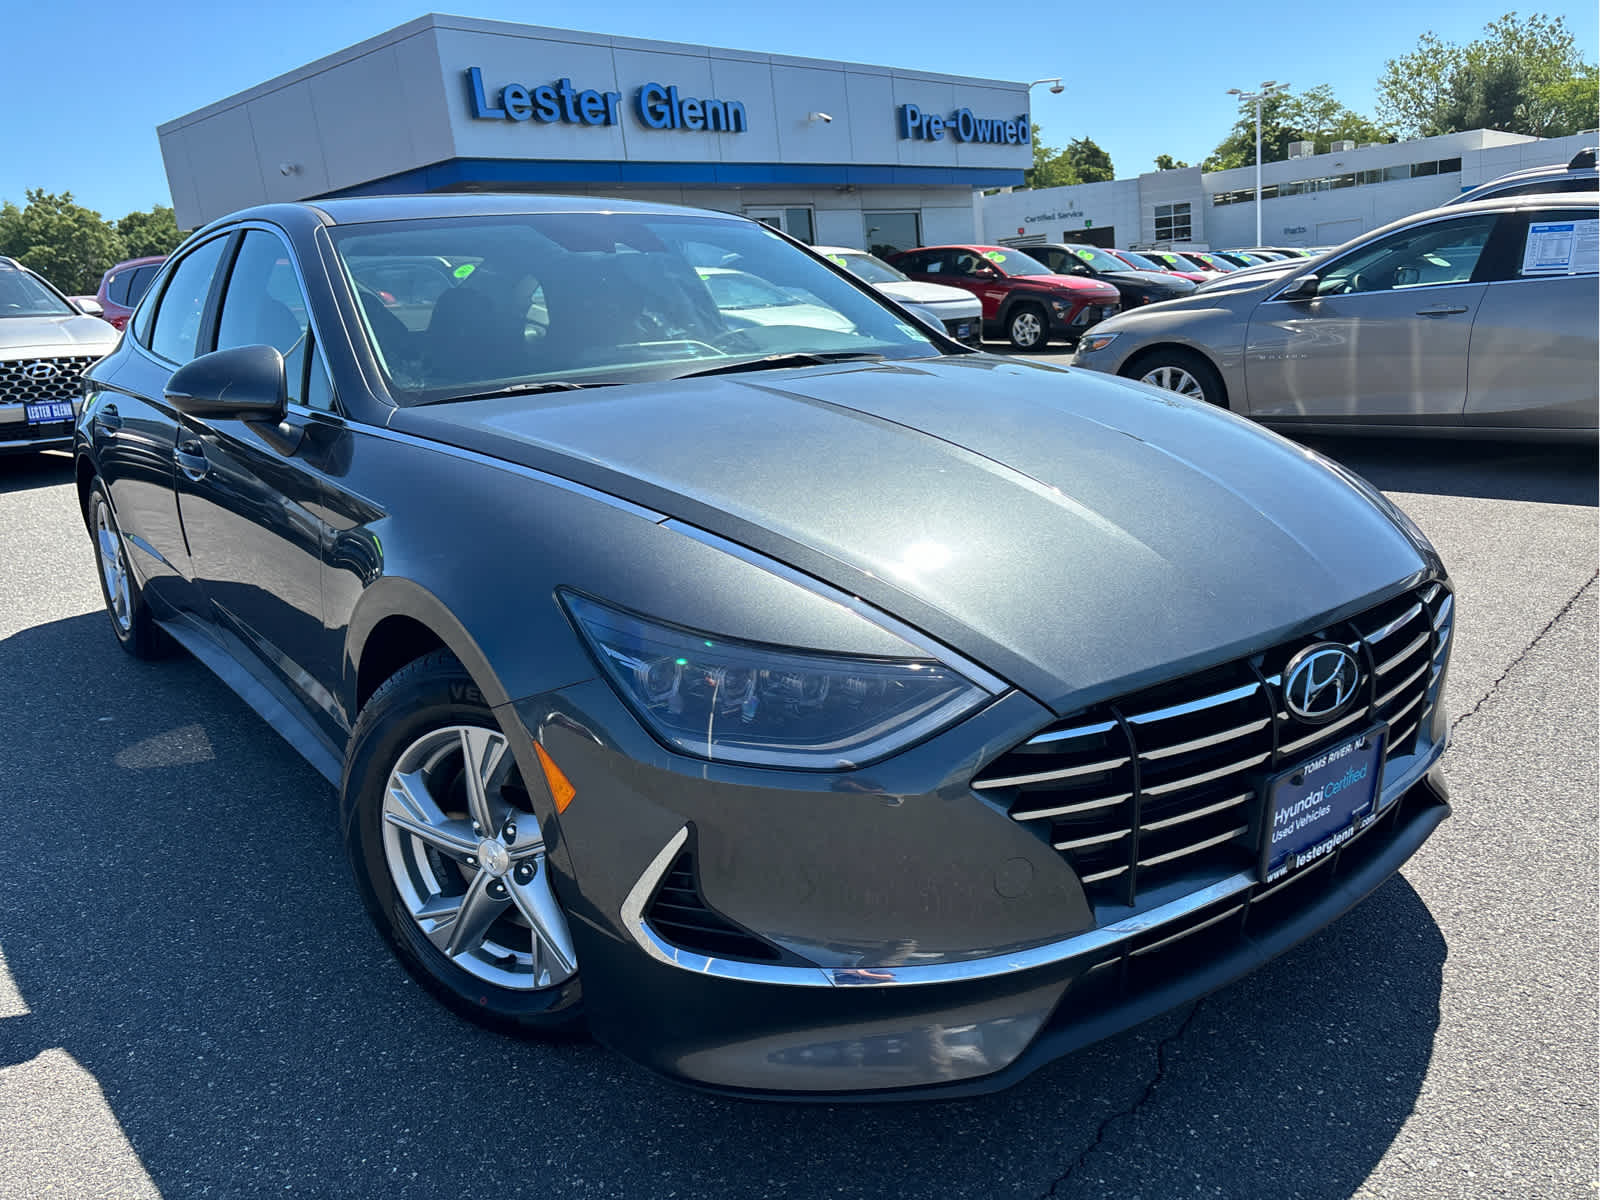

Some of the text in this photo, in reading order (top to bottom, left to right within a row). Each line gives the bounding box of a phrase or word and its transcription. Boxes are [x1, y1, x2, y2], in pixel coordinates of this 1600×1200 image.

[464, 66, 748, 133] Lester Glenn
[899, 103, 1031, 145] Pre-Owned
[1024, 210, 1084, 224] Certified Service
[27, 403, 73, 419] LESTER GLENN
[450, 682, 487, 704] VE
[1304, 756, 1327, 776] TOMS
[1354, 736, 1366, 751] NJ
[1273, 761, 1368, 828] Hyundai Certified
[1271, 821, 1295, 844] Used
[1295, 804, 1332, 830] Vehicles
